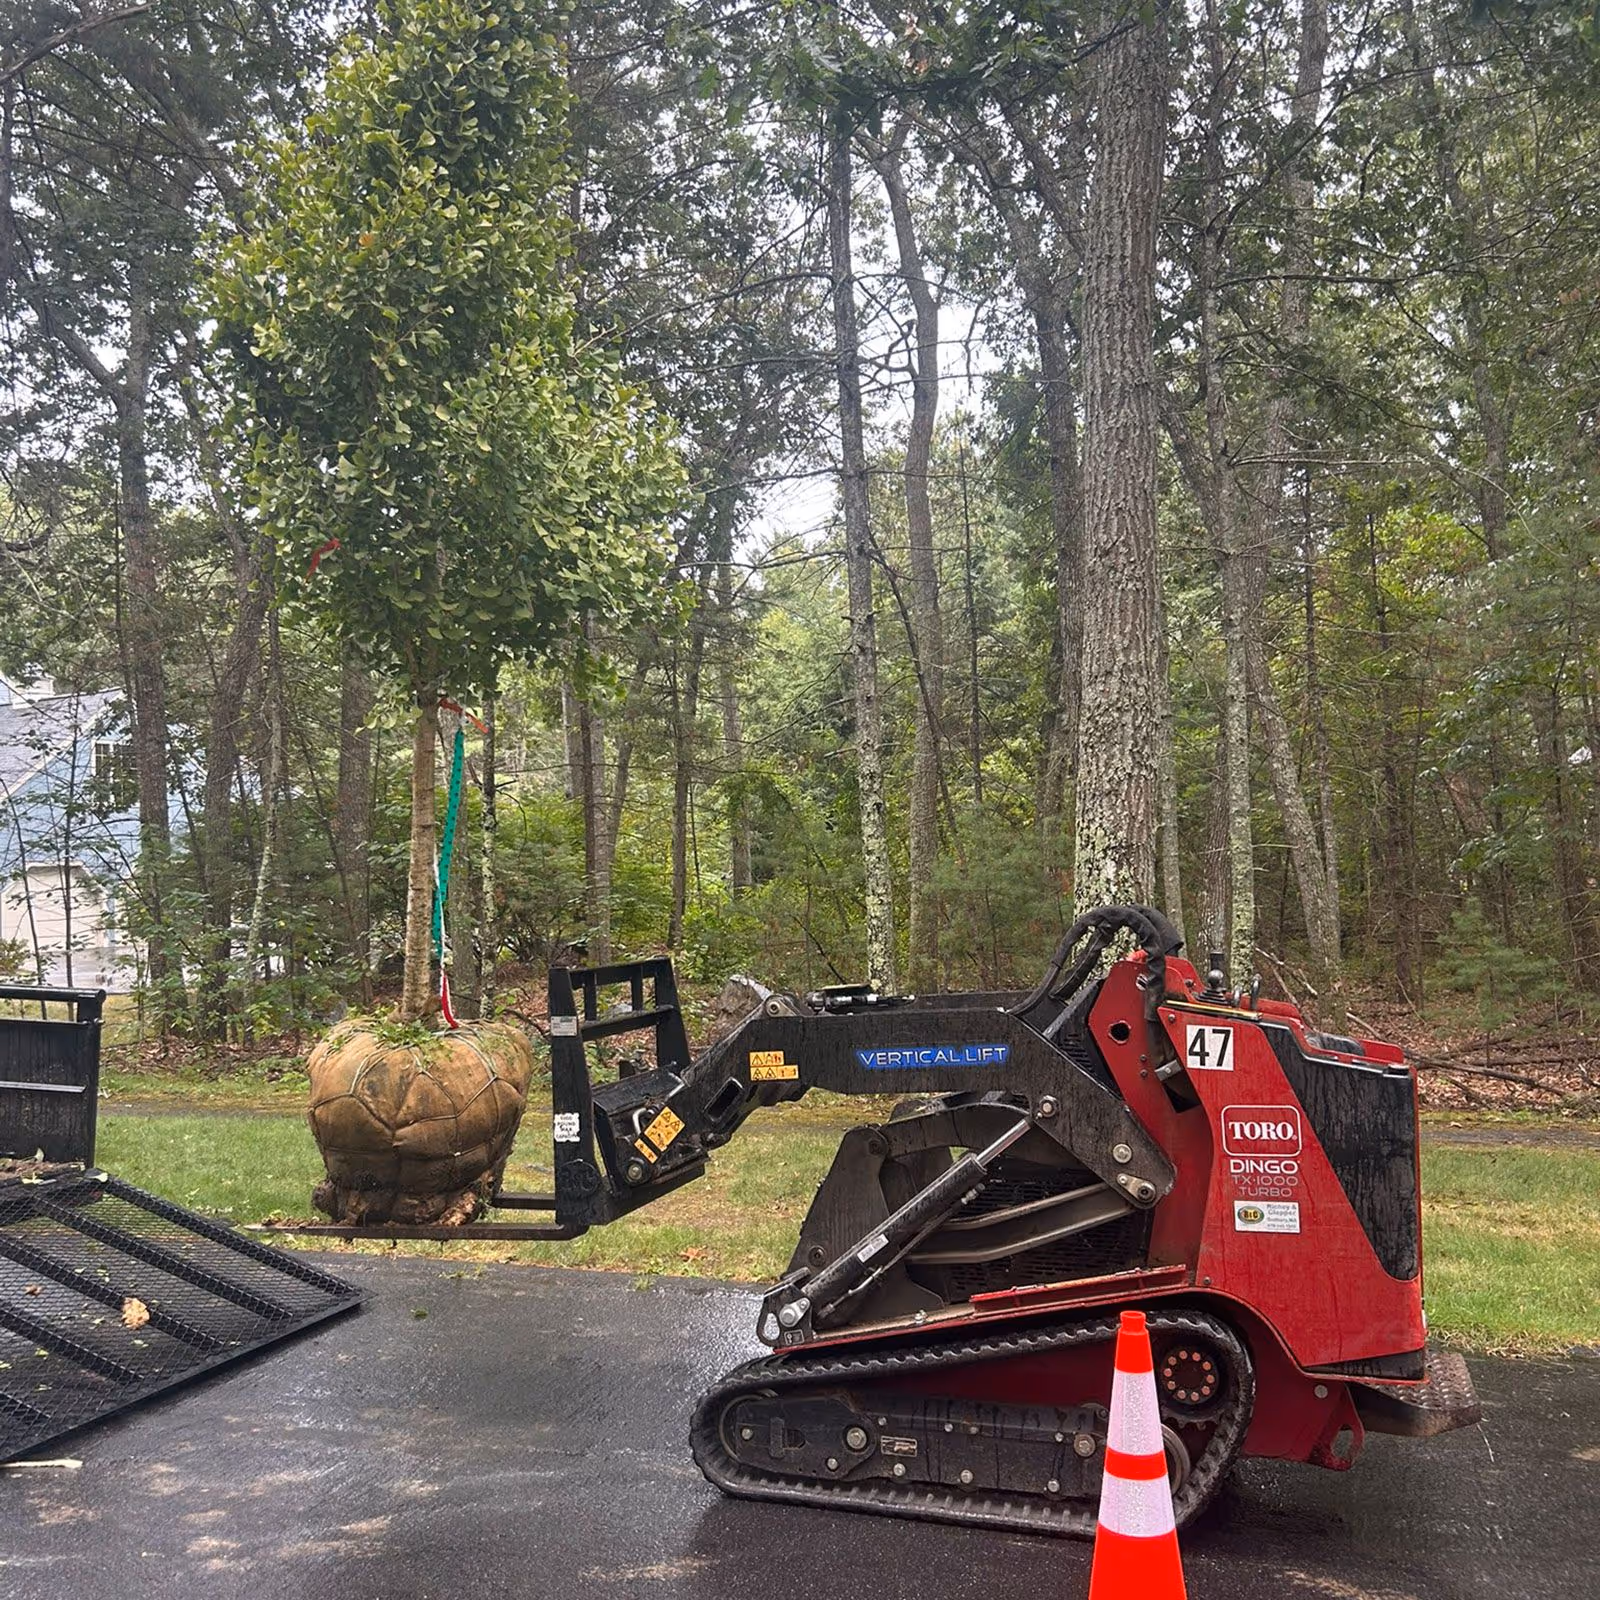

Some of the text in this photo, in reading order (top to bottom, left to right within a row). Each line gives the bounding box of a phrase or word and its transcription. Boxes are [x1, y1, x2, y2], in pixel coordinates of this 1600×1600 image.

[860, 1047, 1006, 1065] VERTICAL LIFT
[1188, 1028, 1231, 1067] 47
[1229, 1121, 1294, 1140] TORO
[1229, 1159, 1298, 1174] DINGO
[1239, 1187, 1292, 1197] TURBO
